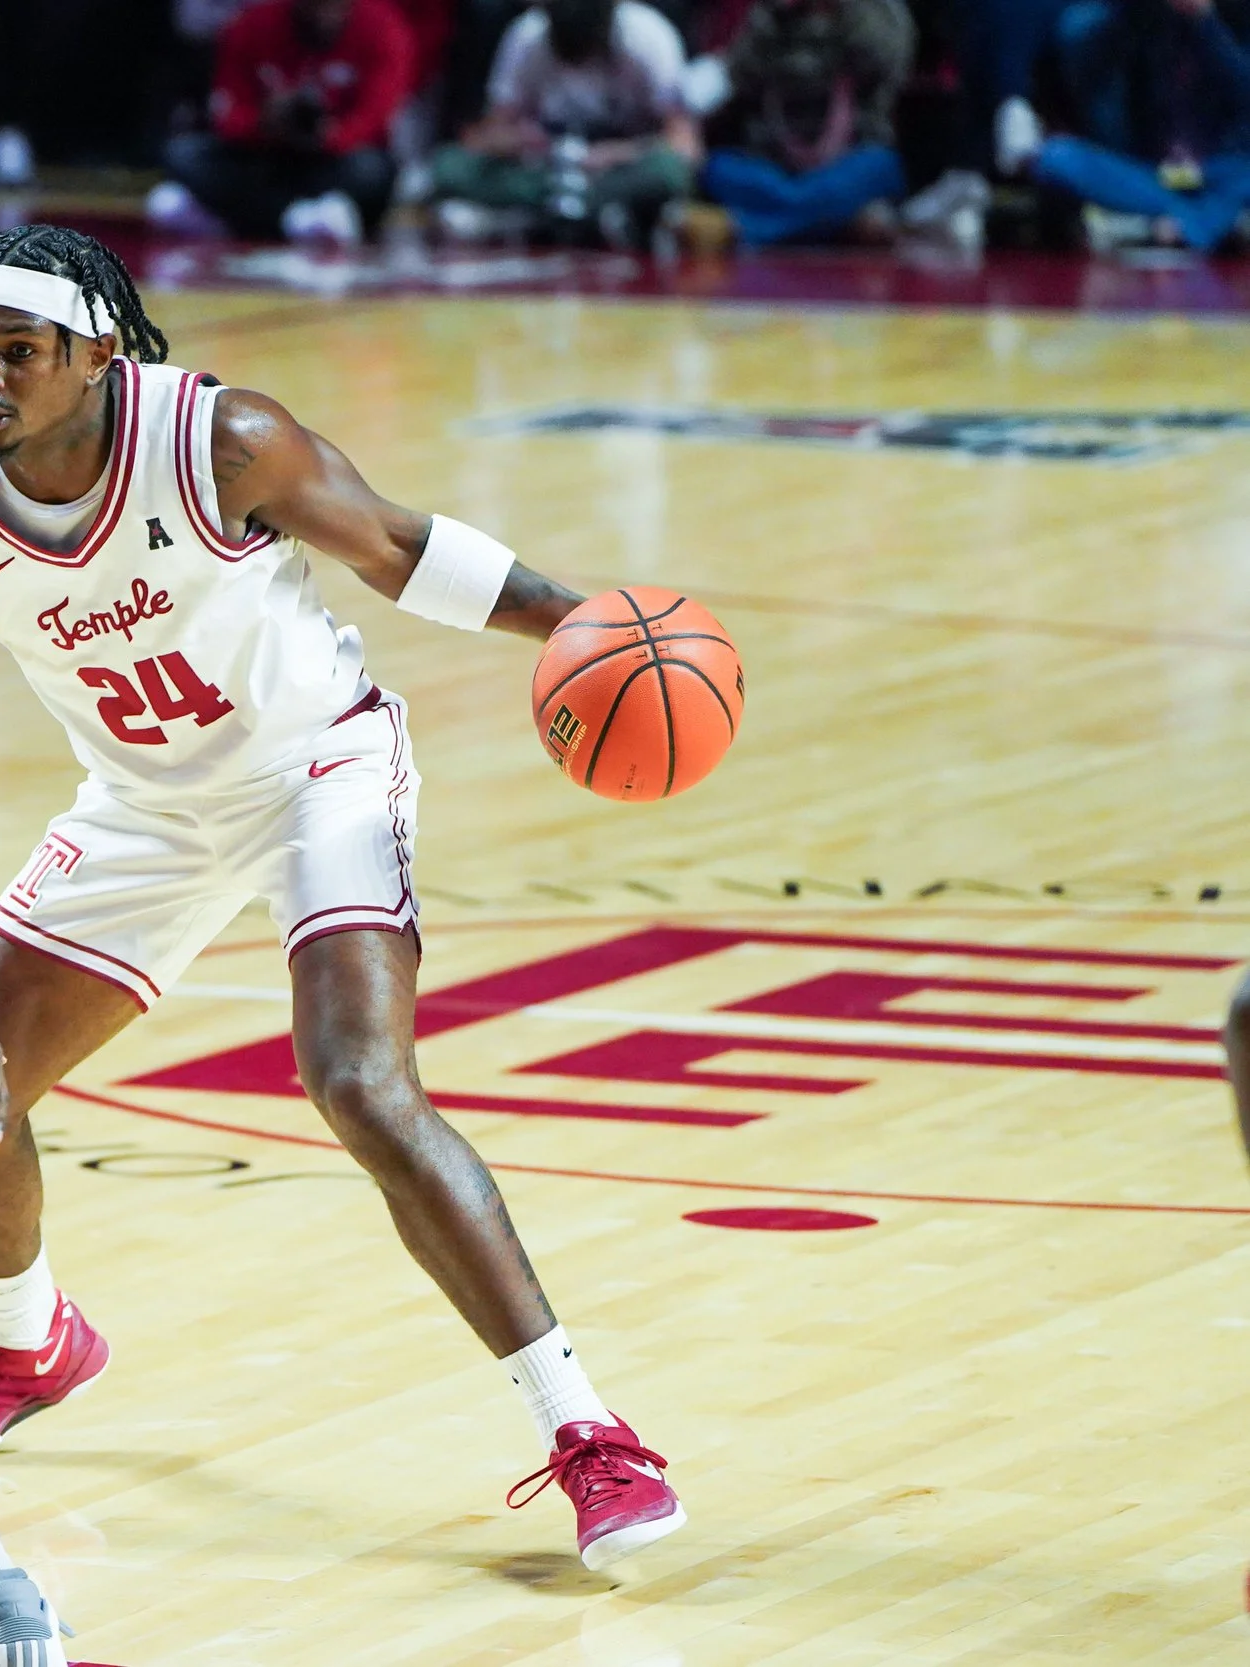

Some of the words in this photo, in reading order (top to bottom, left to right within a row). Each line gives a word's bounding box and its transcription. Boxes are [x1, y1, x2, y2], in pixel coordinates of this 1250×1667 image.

[145, 517, 174, 550] A
[37, 578, 173, 650] Temple
[77, 651, 235, 745] 24
